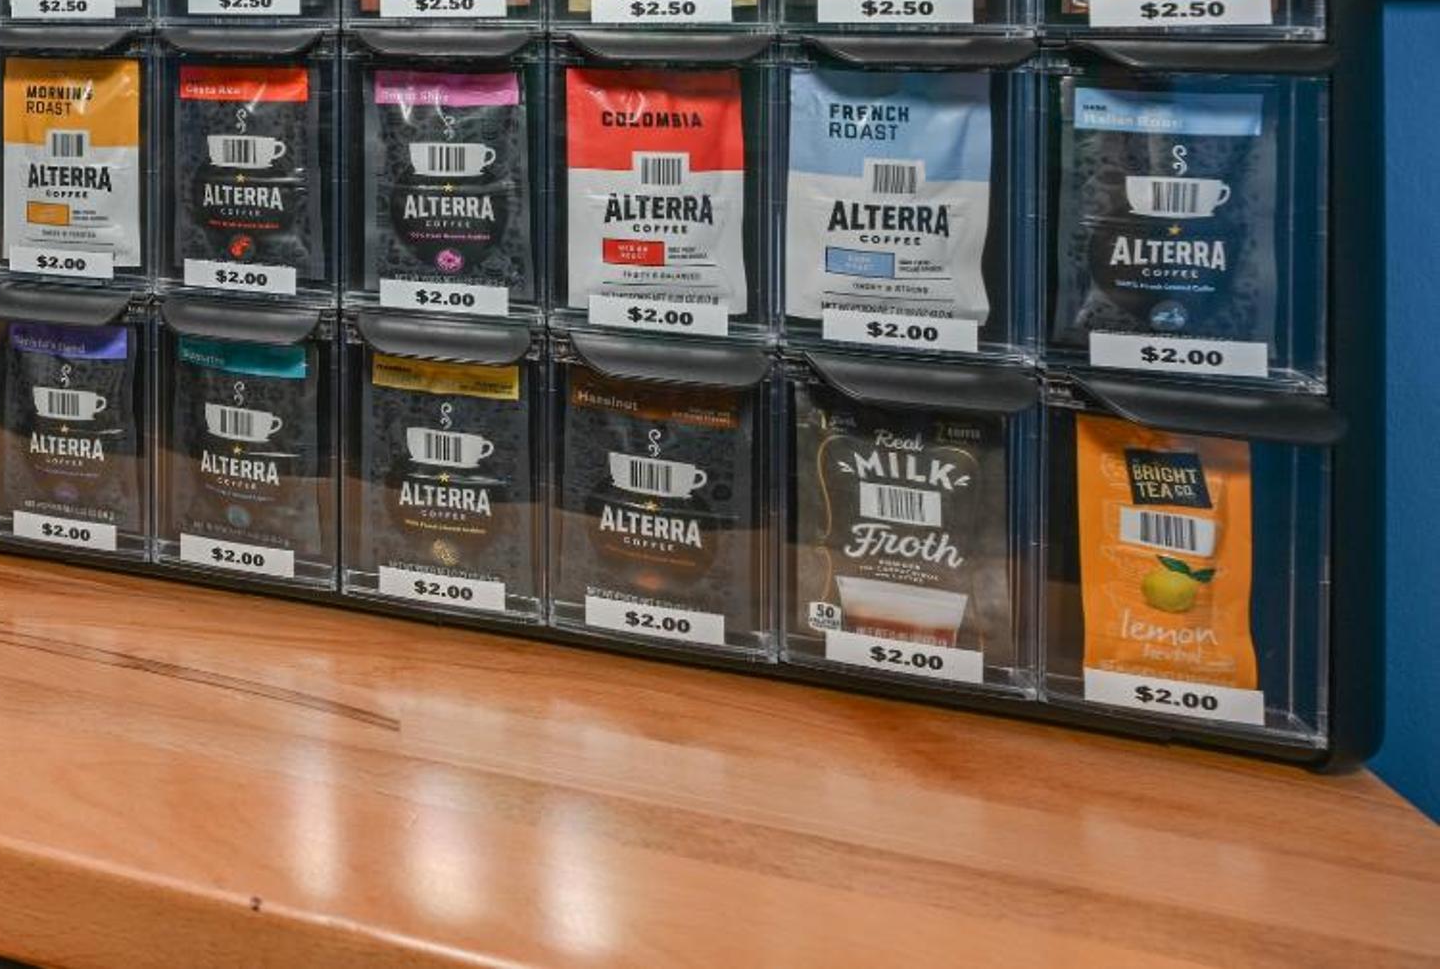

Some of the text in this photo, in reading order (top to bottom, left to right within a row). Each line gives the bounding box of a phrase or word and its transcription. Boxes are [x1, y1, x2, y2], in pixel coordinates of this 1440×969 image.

[39, 0, 88, 14] $2.50
[630, 1, 696, 17] $2.50
[861, 0, 934, 17] $2.50
[1140, 1, 1225, 20] $2.50
[26, 101, 72, 116] ROAST
[829, 103, 910, 122] FRENCH
[602, 111, 703, 128] COLOMBIA
[829, 121, 898, 140] ROAST
[28, 163, 112, 192] ALTERRA
[45, 190, 88, 199] COFFEE
[203, 183, 284, 212] ALTERRA
[403, 195, 496, 221] ALTERRA
[604, 193, 714, 225] ALTERRA
[425, 220, 471, 228] COFFEE
[827, 200, 950, 238] ALTERRA
[633, 224, 688, 235] COFFEE
[859, 234, 921, 246] COFFEE
[37, 255, 86, 271] $2.00
[1110, 236, 1226, 271] ALTERRA
[215, 269, 268, 286] $2.00
[1142, 267, 1198, 278] COFFEE
[416, 290, 475, 307] $2.00
[627, 307, 694, 326] $2.00
[866, 321, 939, 341] $2.00
[1140, 346, 1223, 367] $2.00
[577, 391, 638, 411] Hazelnut
[30, 432, 104, 461] ALTERRA
[875, 430, 924, 451] Real
[201, 450, 279, 486] ALTERRA
[854, 451, 957, 490] MILK
[1133, 465, 1199, 484] BRIGHT
[399, 481, 491, 516] ALTERRA
[1136, 483, 1172, 498] TEA
[421, 510, 465, 521] COFFEE
[42, 522, 90, 541] $2.00
[600, 505, 702, 549] ALTERRA
[623, 536, 674, 552] COFFEE
[844, 523, 964, 568] Froth
[211, 547, 264, 567] $2.00
[414, 580, 473, 600] $2.00
[816, 604, 835, 618] 50
[625, 611, 690, 633] $2.00
[1121, 608, 1218, 646] lemon
[869, 646, 943, 670] $2.00
[1135, 685, 1218, 710] $2.00
